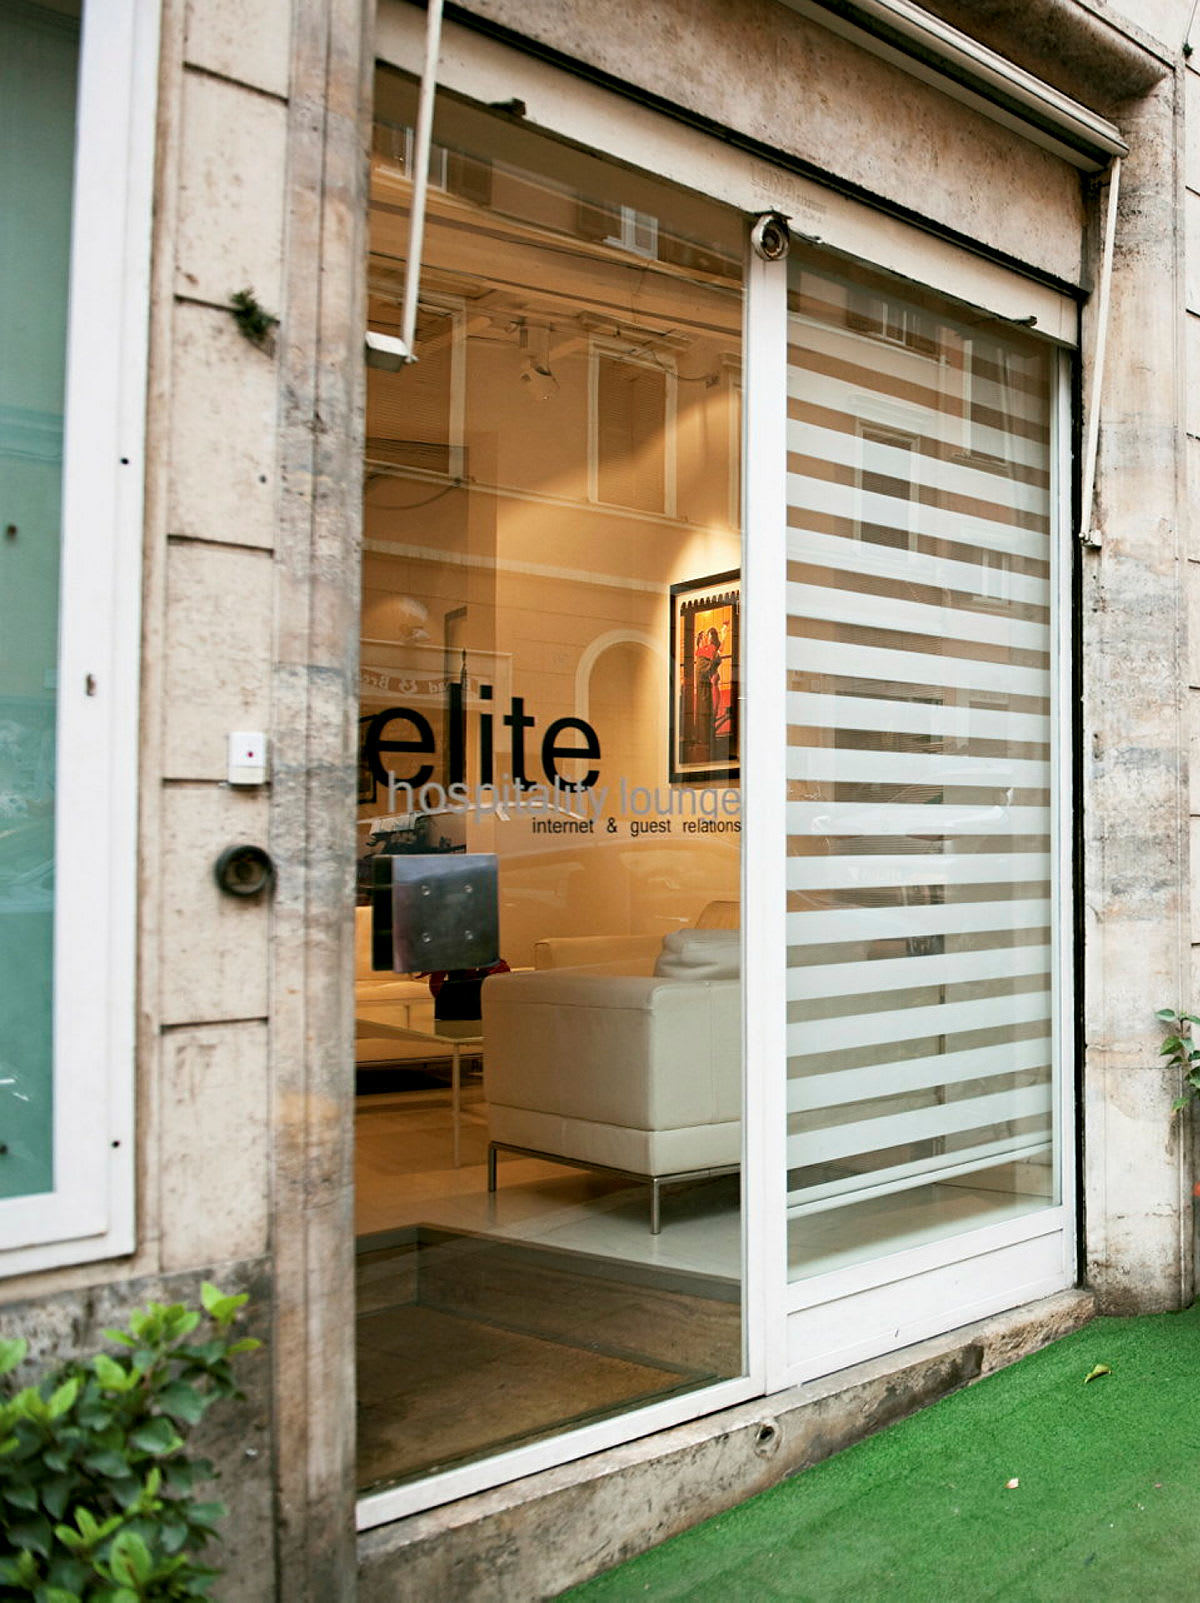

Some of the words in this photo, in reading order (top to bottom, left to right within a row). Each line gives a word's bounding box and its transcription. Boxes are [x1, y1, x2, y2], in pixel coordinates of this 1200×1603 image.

[366, 682, 601, 793] elite
[388, 770, 608, 824] hospitality
[620, 777, 741, 822] lounge
[532, 818, 594, 834] internet
[606, 817, 618, 834] &
[630, 819, 671, 837] guest
[682, 817, 742, 834] relations
